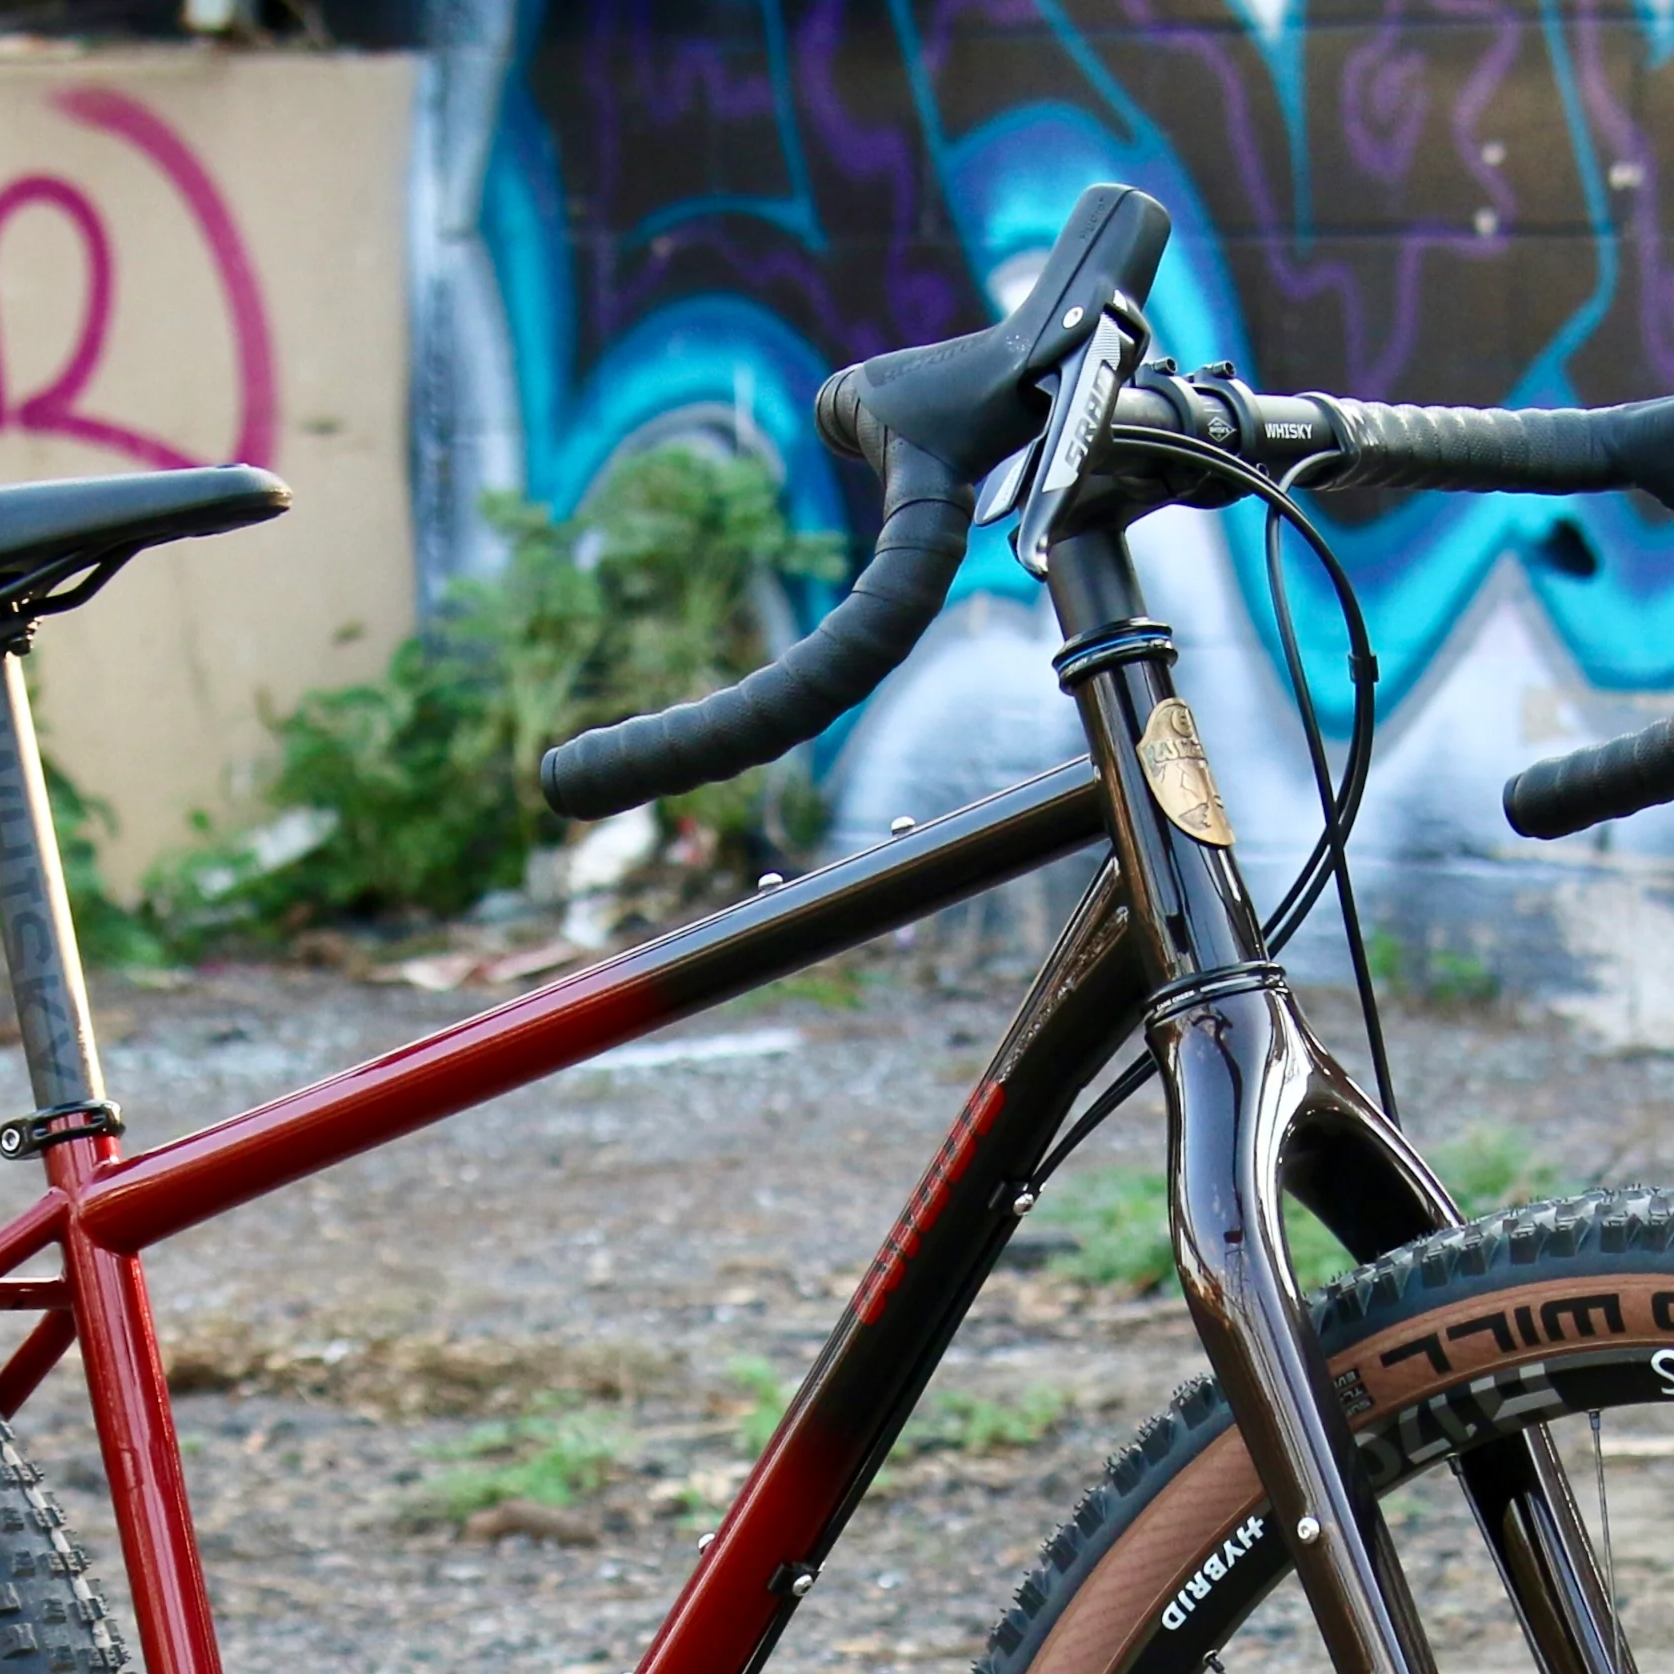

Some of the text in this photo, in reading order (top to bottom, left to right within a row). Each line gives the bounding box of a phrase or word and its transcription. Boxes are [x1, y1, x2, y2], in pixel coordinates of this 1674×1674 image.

[1265, 423, 1312, 439] WHISKY
[1379, 1292, 1625, 1374] WILL
[1161, 1515, 1266, 1632] HYBRID
